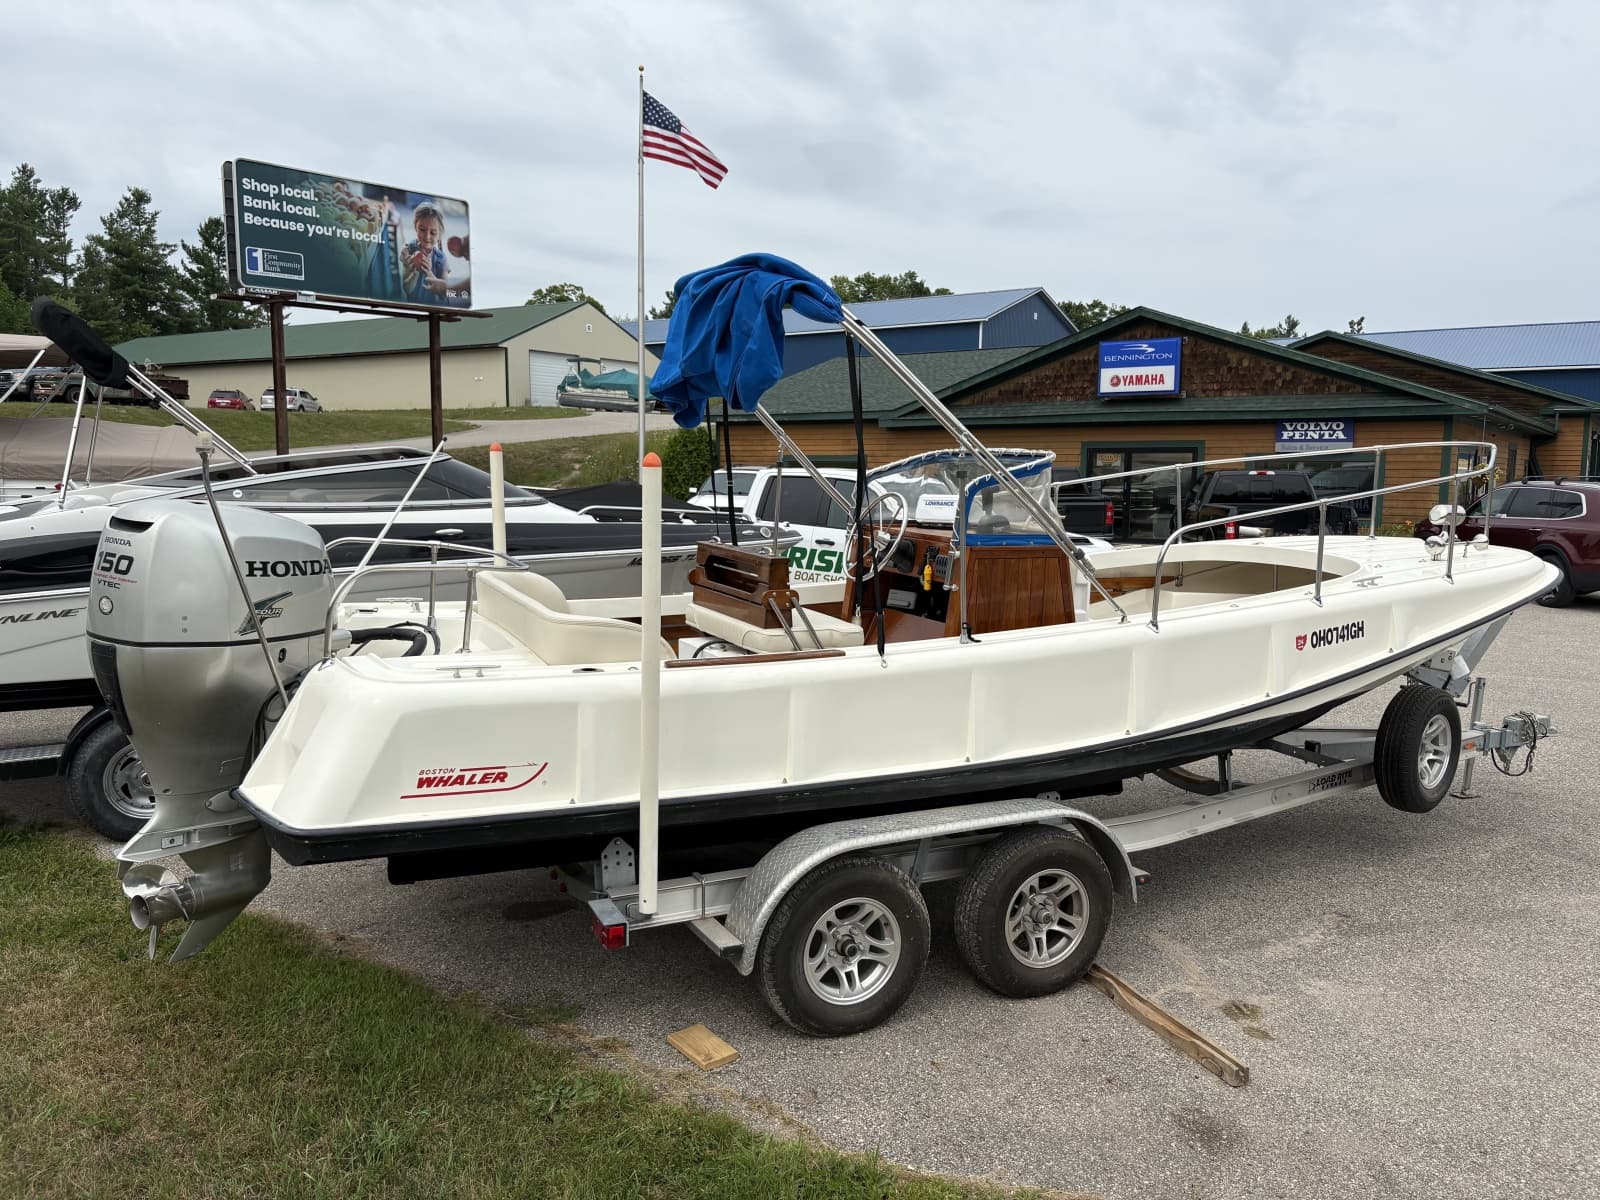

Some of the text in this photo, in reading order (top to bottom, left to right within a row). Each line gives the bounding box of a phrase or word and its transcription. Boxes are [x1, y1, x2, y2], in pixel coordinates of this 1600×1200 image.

[242, 177, 319, 202] Shop local.
[243, 195, 321, 218] Bank local.
[244, 212, 385, 244] Because you're local.
[1104, 352, 1173, 362] BENNINGTON
[1122, 373, 1165, 387] YAMAHA
[1282, 421, 1345, 431] VOLVO
[1281, 430, 1348, 440] PENTA
[104, 536, 132, 547] HONDA
[97, 551, 134, 575] 150
[245, 559, 332, 577] HONDA
[97, 578, 121, 589] VTEC
[794, 571, 821, 583] BOAT
[0, 606, 87, 625] NLINE
[416, 771, 508, 789] WHALER
